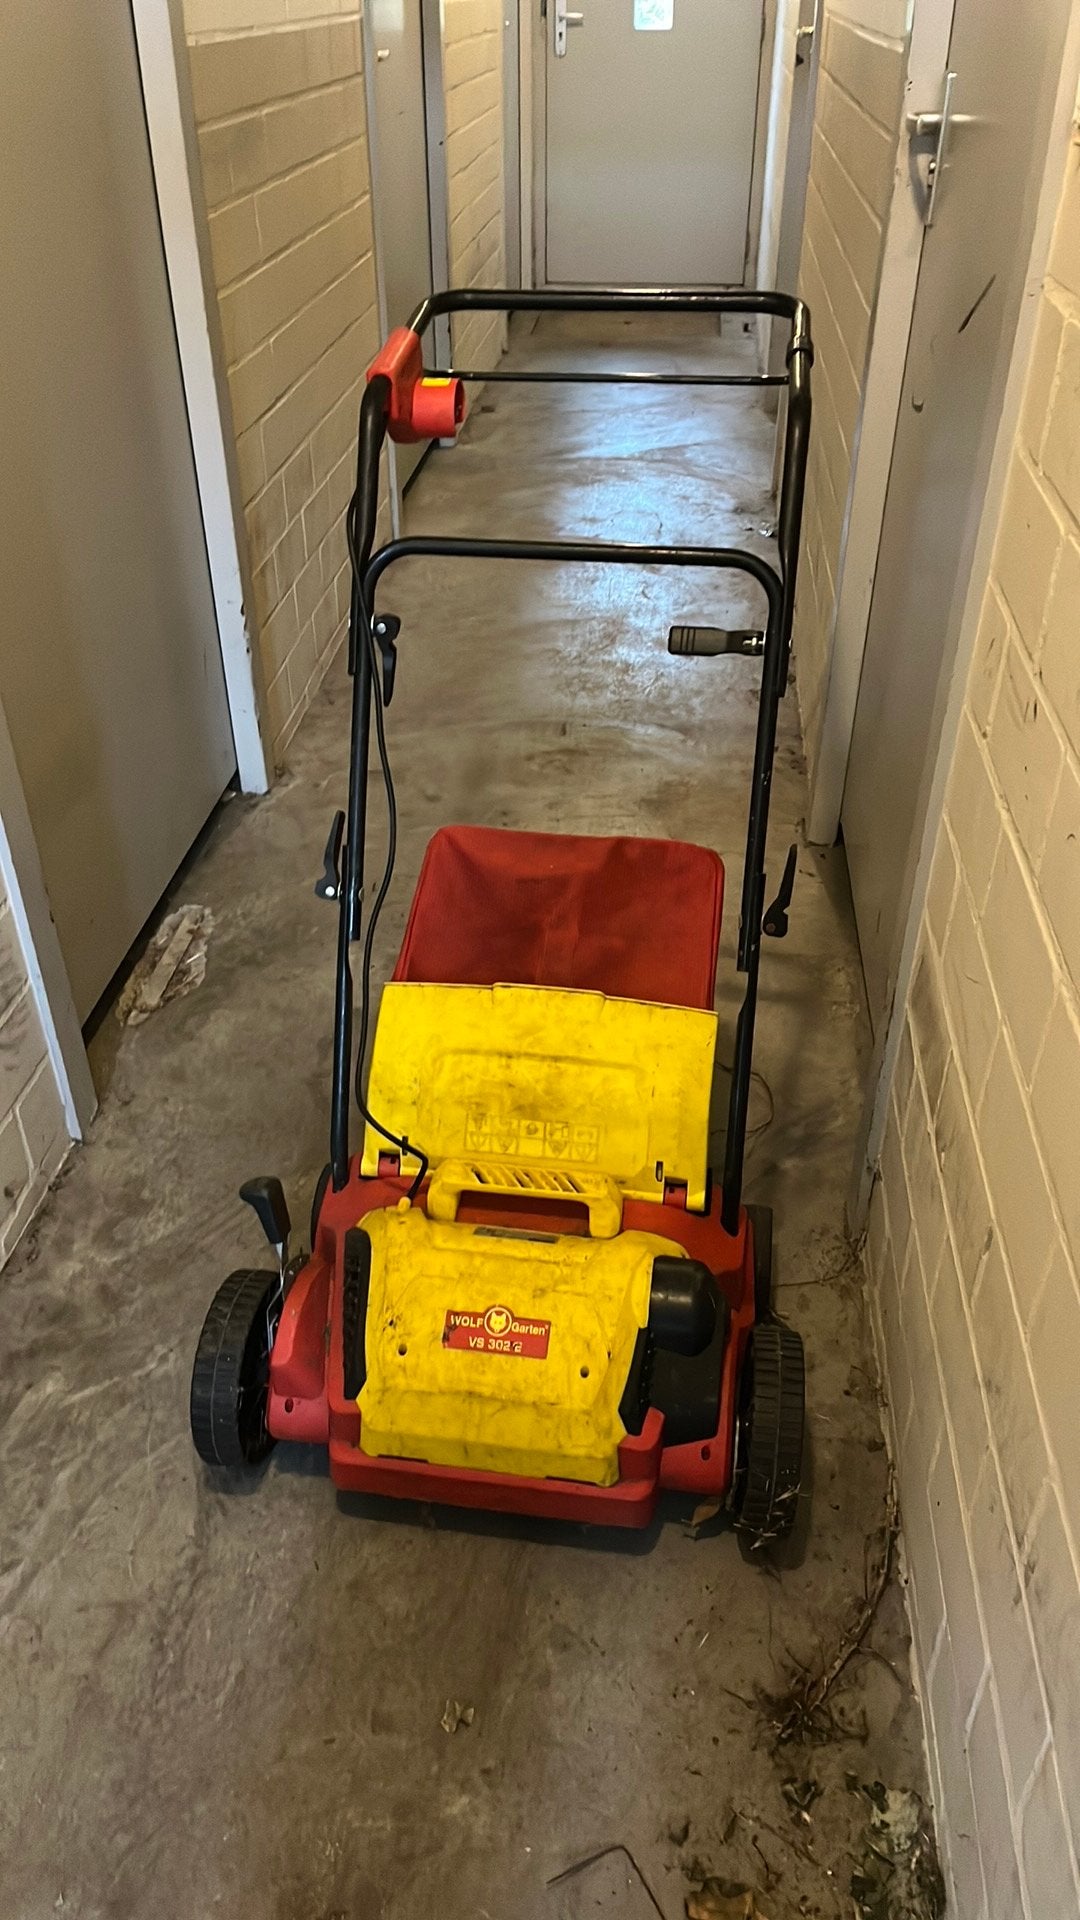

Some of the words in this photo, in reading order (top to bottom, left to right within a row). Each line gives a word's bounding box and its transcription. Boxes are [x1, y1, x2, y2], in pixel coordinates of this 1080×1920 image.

[450, 1314, 483, 1328] WOLF
[469, 1336, 484, 1348] VS
[488, 1338, 510, 1351] 302
